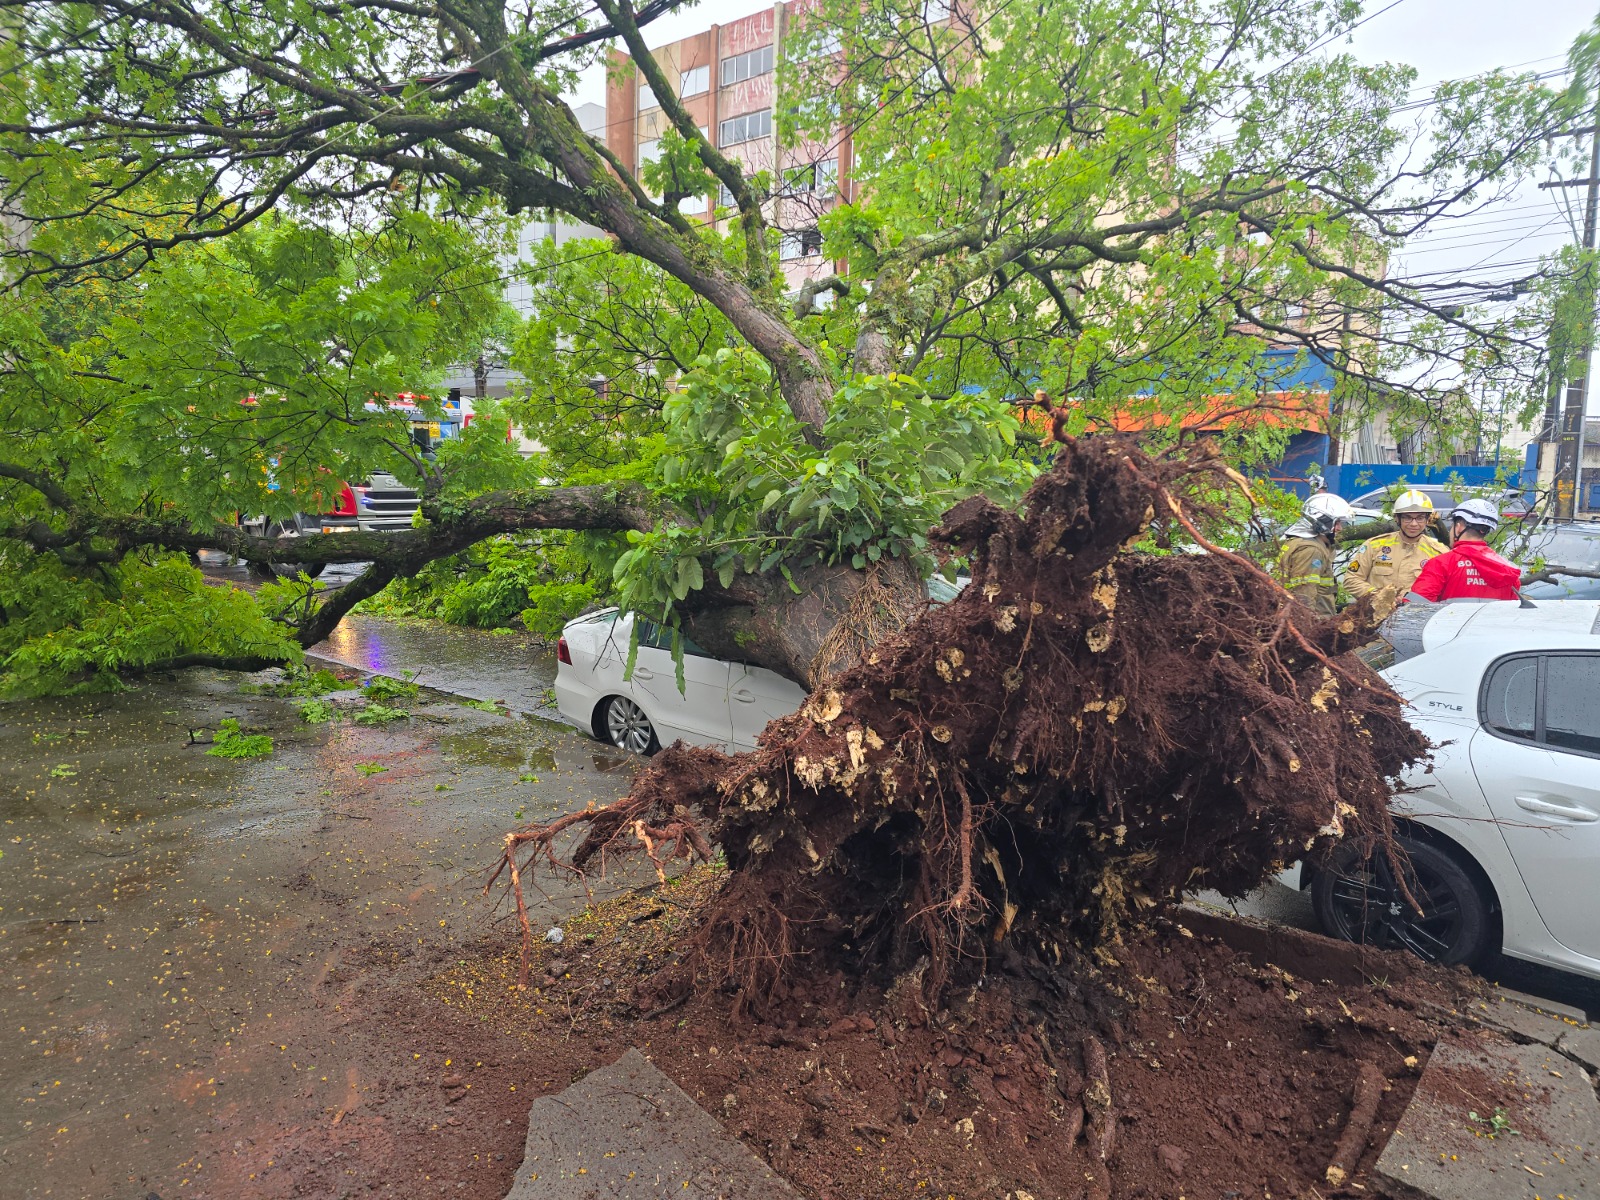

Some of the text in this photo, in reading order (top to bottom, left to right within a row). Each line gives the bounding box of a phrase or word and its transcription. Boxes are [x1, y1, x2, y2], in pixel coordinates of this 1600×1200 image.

[1457, 559, 1475, 568] BO
[1466, 568, 1480, 576] MI
[1466, 577, 1488, 586] PAR
[1428, 701, 1464, 711] STYLE
